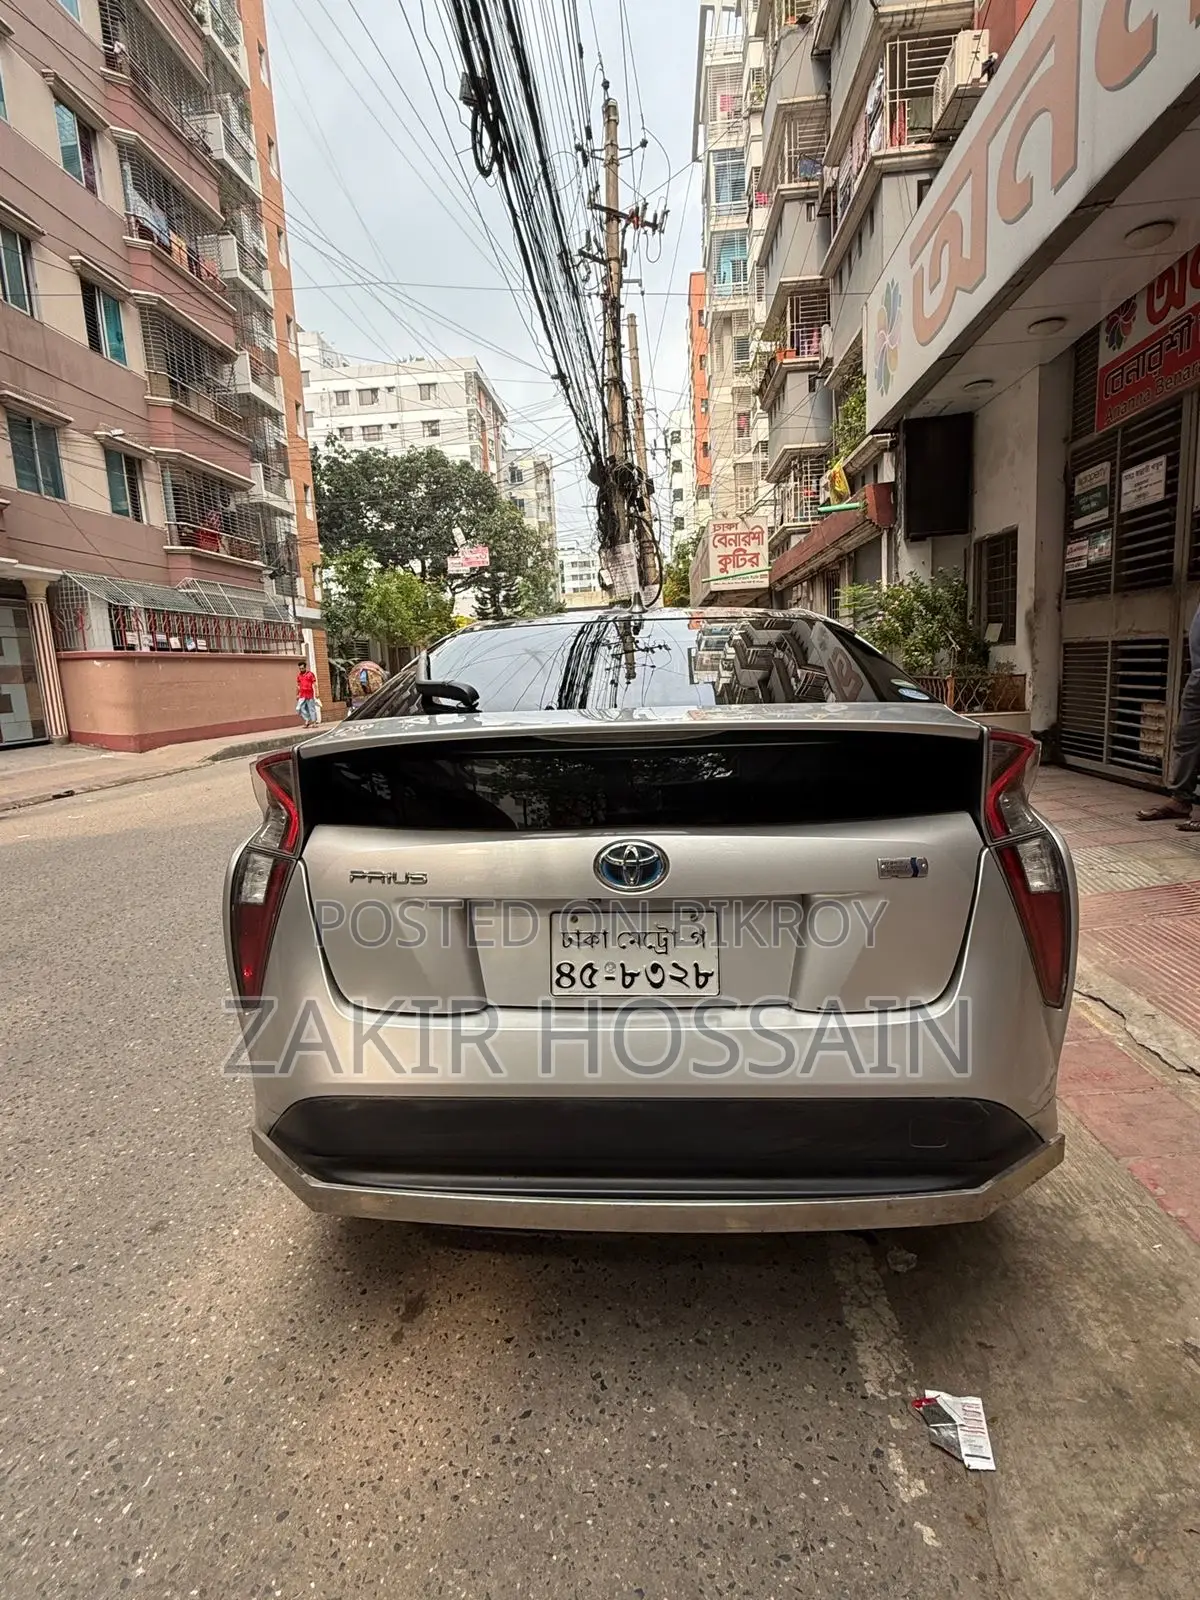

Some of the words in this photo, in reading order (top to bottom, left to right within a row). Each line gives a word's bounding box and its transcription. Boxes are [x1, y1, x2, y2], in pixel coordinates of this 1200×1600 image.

[713, 523, 739, 532] ঢাকা
[713, 525, 765, 548] বেনারশী
[717, 548, 760, 574] কুটির
[349, 869, 428, 885] PRIUS
[562, 928, 608, 949] ঢাকা
[555, 962, 714, 989] ৪৫-৮৩২৮
